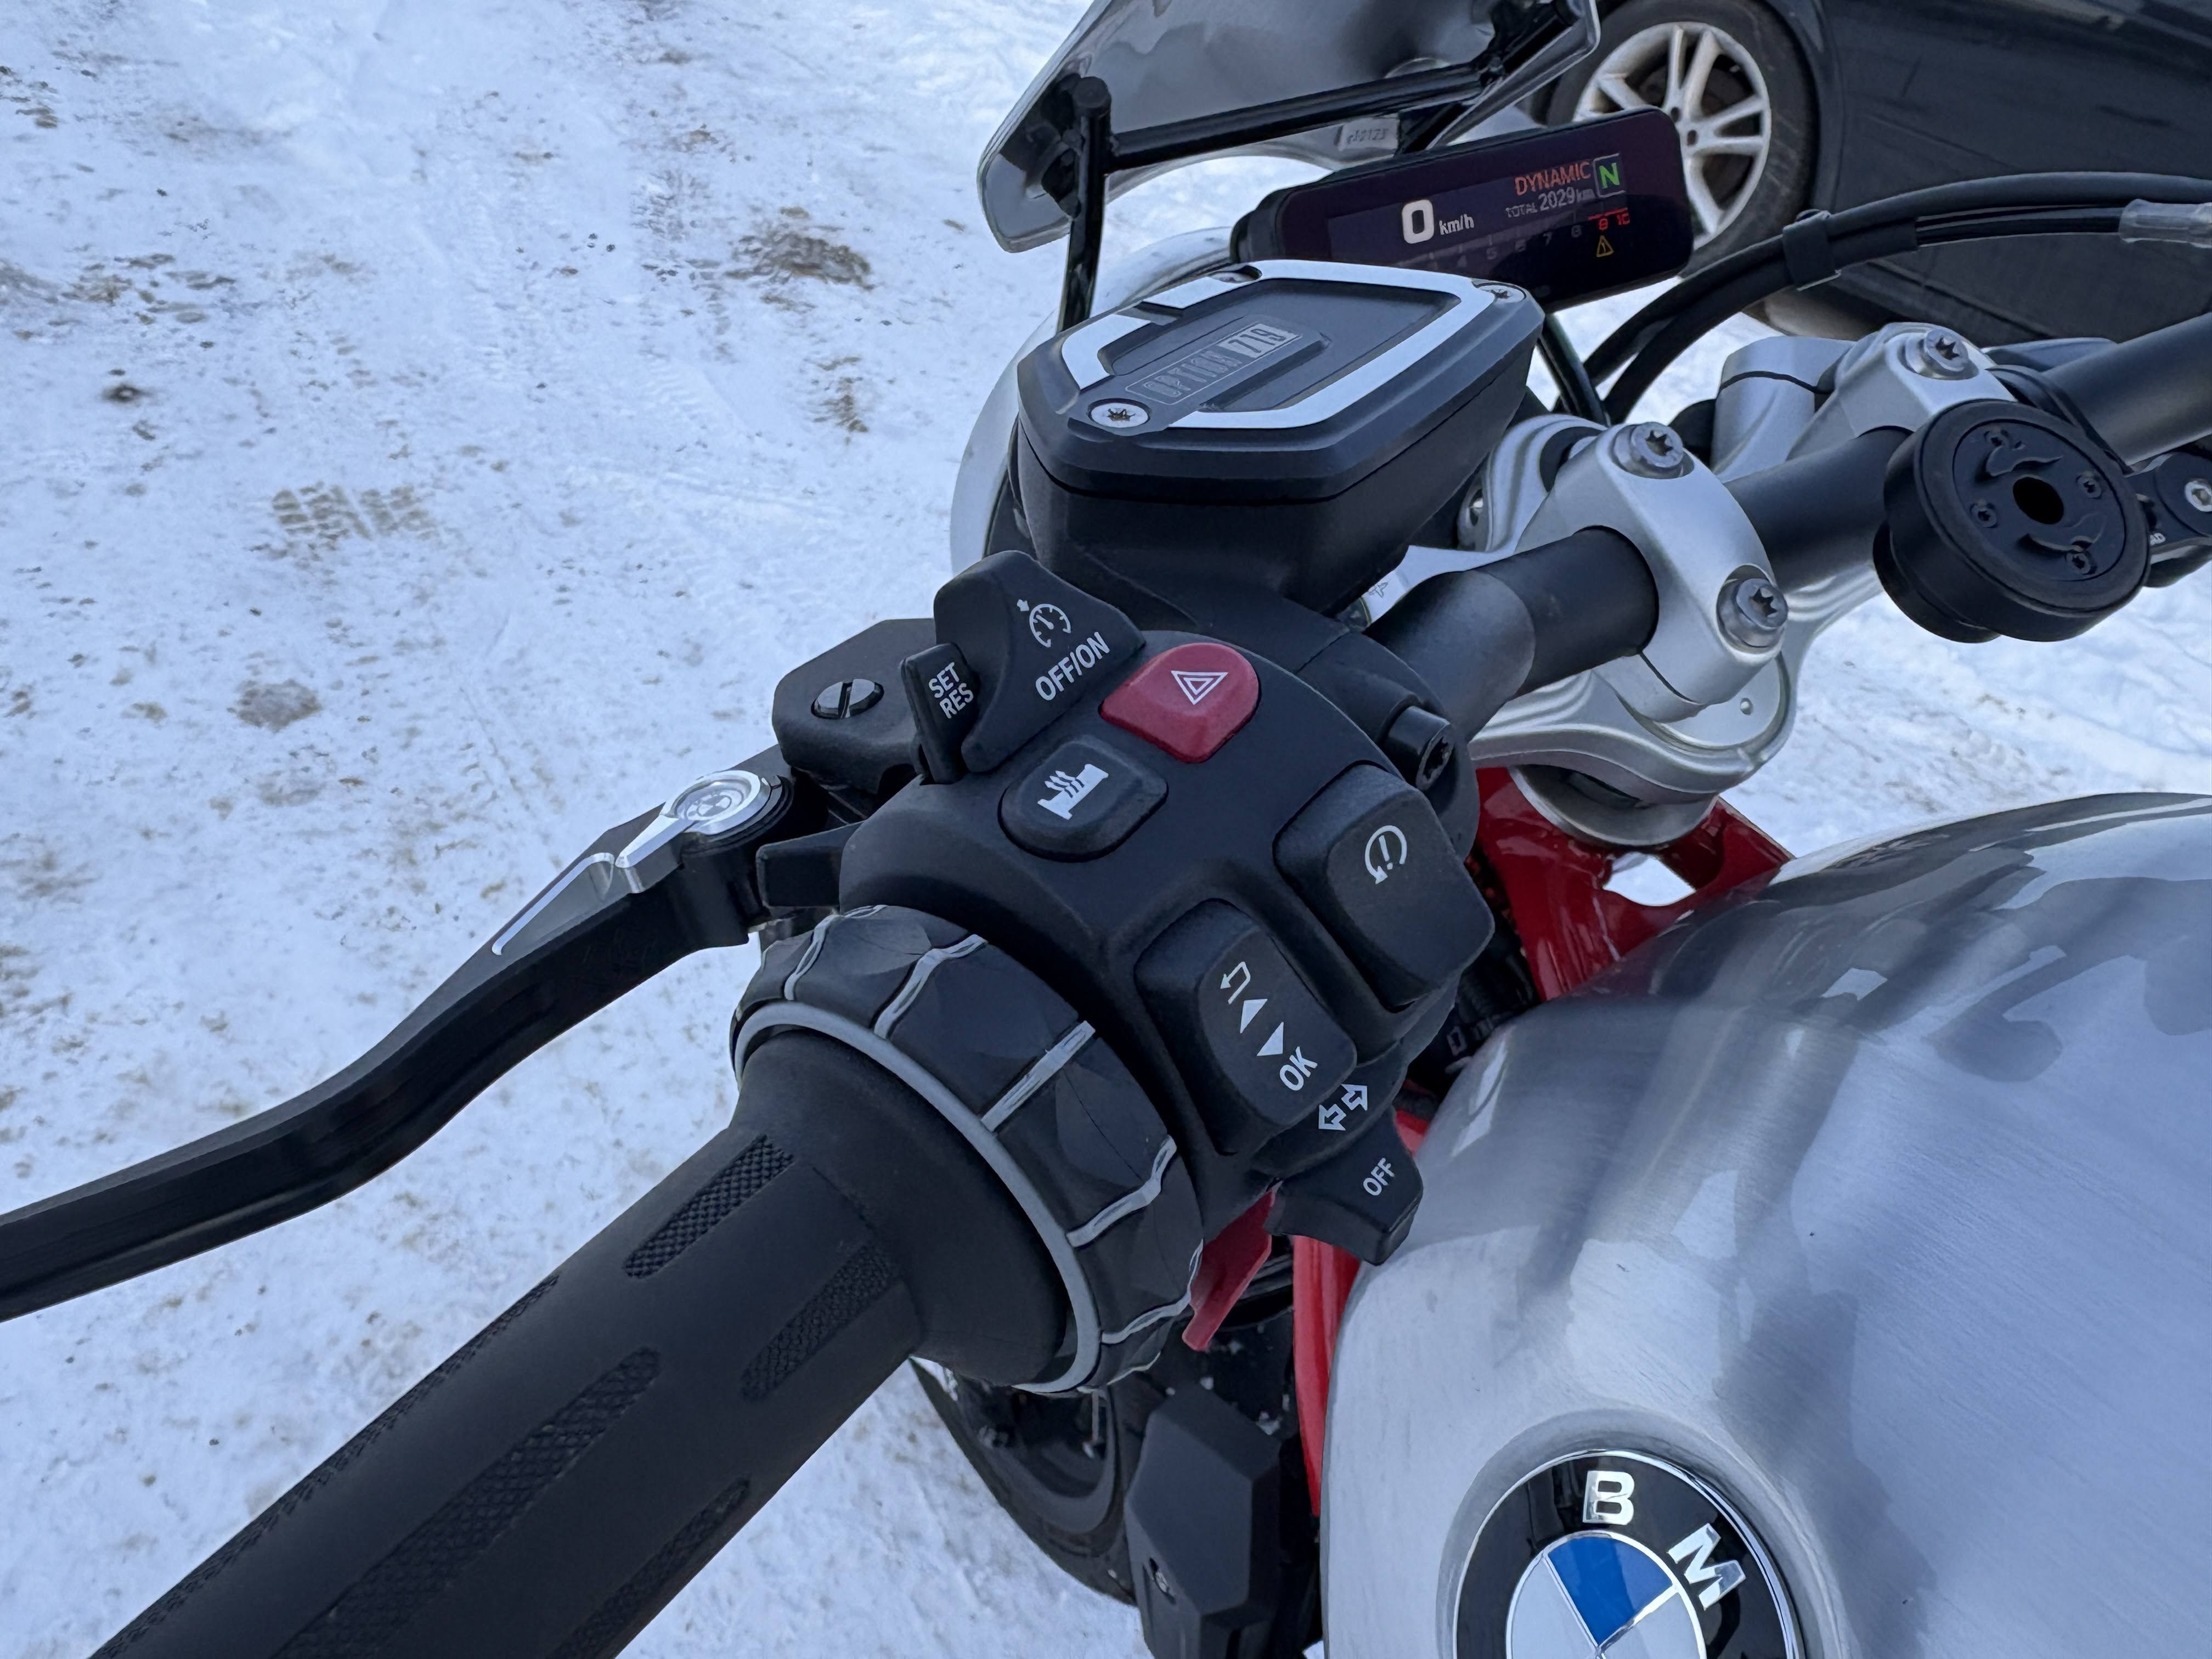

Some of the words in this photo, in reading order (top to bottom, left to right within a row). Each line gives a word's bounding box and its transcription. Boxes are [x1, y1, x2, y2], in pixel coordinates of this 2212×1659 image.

[1514, 161, 1591, 196] DYNAMIC
[1598, 162, 1620, 189] N
[1505, 202, 1538, 218] TOTAL
[1538, 187, 1576, 211] 2029
[1402, 199, 1435, 244] 0
[1438, 213, 1475, 235] km/h
[1543, 232, 1553, 246] 7
[1616, 212, 1631, 226] 10
[1227, 329, 1287, 354] 719
[928, 662, 960, 698] SET
[1035, 631, 1110, 701] OFF/ON
[939, 682, 974, 719] RES
[1279, 1046, 1318, 1091] OK
[1362, 1158, 1395, 1196] OFF
